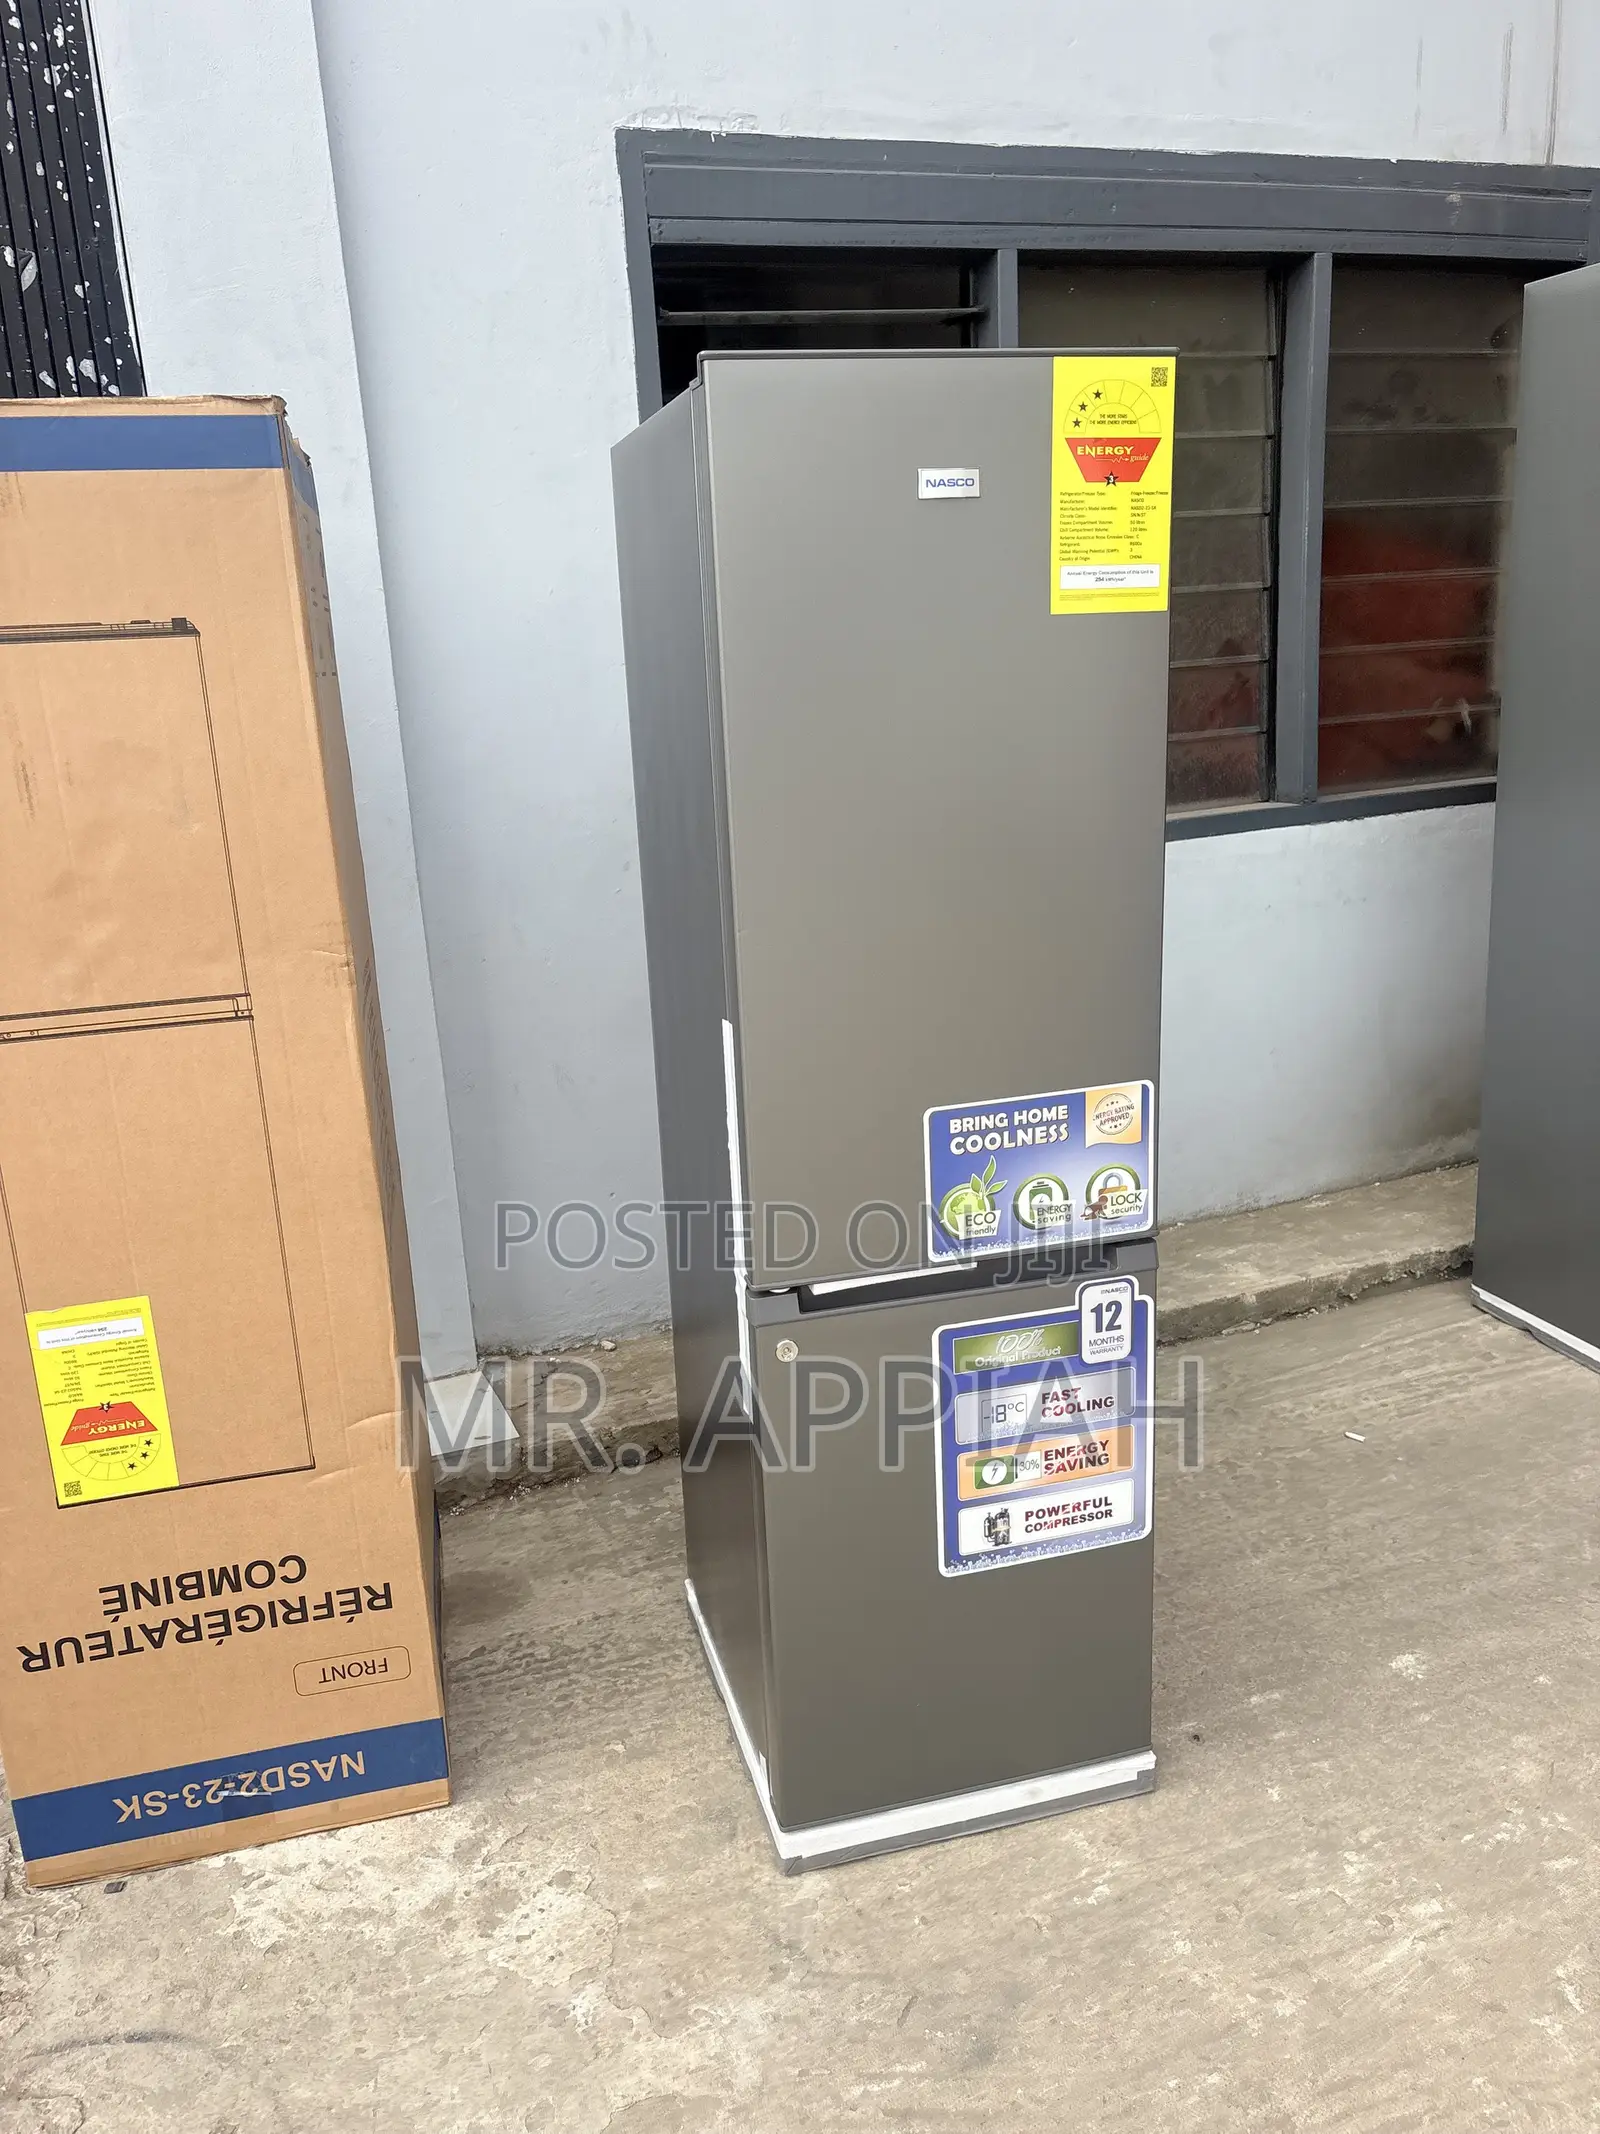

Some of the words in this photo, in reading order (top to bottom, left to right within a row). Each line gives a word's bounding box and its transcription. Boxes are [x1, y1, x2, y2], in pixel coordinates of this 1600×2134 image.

[1076, 444, 1134, 458] ENERGY
[1130, 453, 1149, 463] guide
[926, 478, 974, 488] NASCO
[949, 1113, 1009, 1134] BRING
[1014, 1105, 1069, 1126] HOME
[1099, 1112, 1130, 1126] APPROVED
[949, 1122, 1070, 1156] COOLNESS
[1110, 1192, 1142, 1206] LOCK
[1037, 1204, 1072, 1216] ENERGY
[1111, 1205, 1142, 1216] security
[966, 1211, 996, 1226] ECO
[1037, 1213, 1072, 1225] saving
[966, 1226, 996, 1237] friendly
[1090, 1300, 1122, 1333] 12
[996, 1329, 1044, 1354] 100%
[1089, 1335, 1124, 1347] MONTHS
[975, 1352, 1018, 1368] Original
[1022, 1346, 1062, 1360] Product
[1090, 1346, 1124, 1356] WARRANTY
[1042, 1387, 1082, 1404] FAST
[1042, 1396, 1114, 1418] COOLING
[70, 1422, 90, 1432] guide
[88, 1420, 145, 1435] ENERGY
[1044, 1440, 1110, 1462] ENERGY
[1019, 1459, 1040, 1472] 30%
[1044, 1452, 1110, 1476] SAVING
[1025, 1496, 1112, 1522] POWERFUL
[1025, 1509, 1113, 1534] COMPRESSOR
[98, 1554, 308, 1624] COMBINÉ
[16, 1582, 394, 1673] RÉFRIGÉRATEUR
[318, 1658, 390, 1684] FRONT
[112, 1750, 366, 1824] NASD2-23-SK
